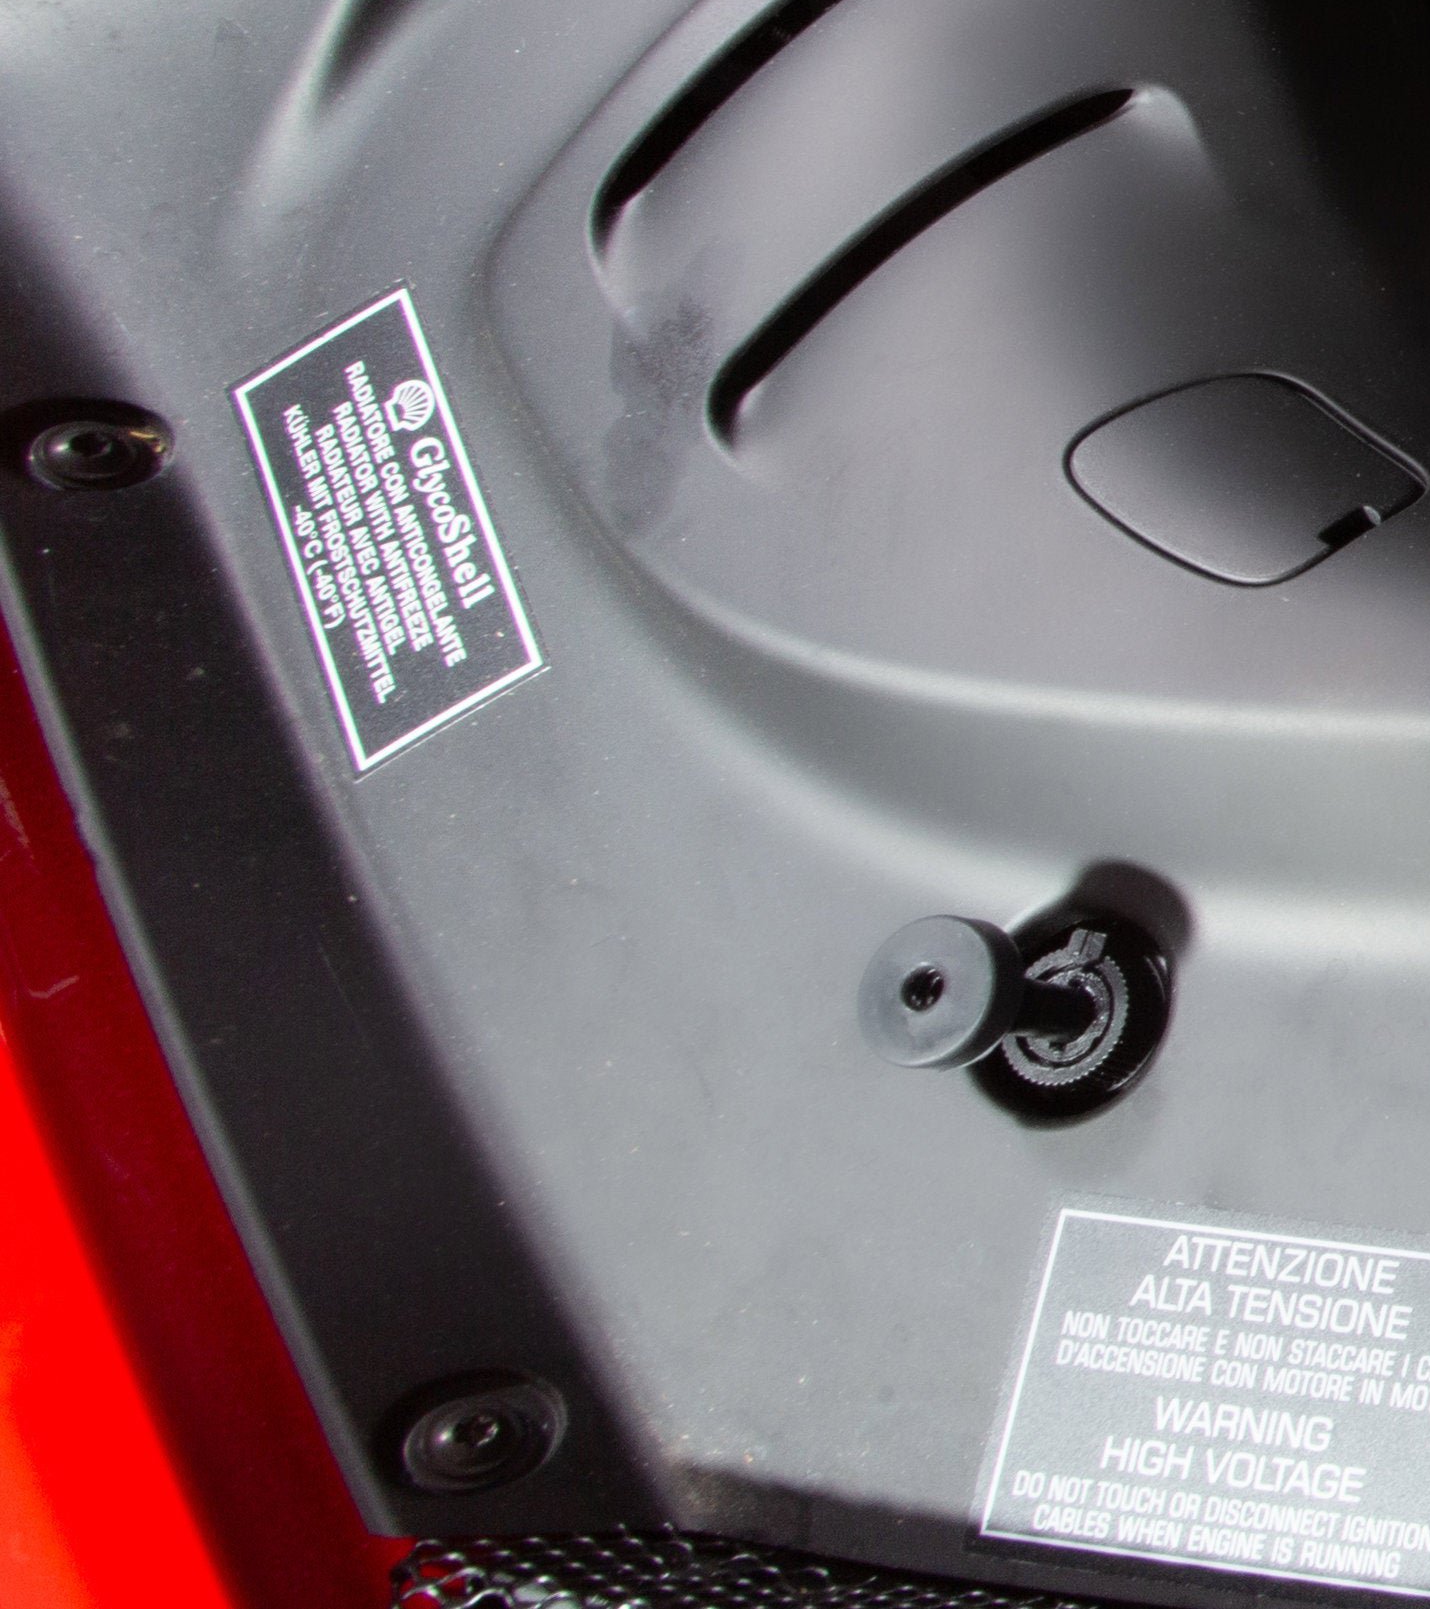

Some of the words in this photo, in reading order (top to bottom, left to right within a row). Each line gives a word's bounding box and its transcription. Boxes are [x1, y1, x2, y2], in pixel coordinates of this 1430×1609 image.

[284, 405, 321, 479] KÜHLER
[346, 361, 394, 463] RADIATORE
[308, 476, 332, 509] MIT
[381, 462, 409, 504] CON
[316, 424, 362, 526] RADIATEUR
[349, 527, 379, 574] AVEC
[366, 576, 405, 655] ANTIGEL
[334, 402, 378, 493] RADIATOR
[365, 491, 395, 540] WITH
[380, 541, 433, 651] ANTIFREEZE
[411, 437, 494, 609] GlycoShell
[319, 509, 395, 703] FROSTSCHUTZMITTEL
[394, 505, 466, 666] ANTICONGELANTE
[1163, 1235, 1400, 1294] ATTENZIONE
[1130, 1275, 1211, 1315] ALTA
[1228, 1285, 1412, 1340] TENSIONE
[1056, 1340, 1206, 1382] D'ACCENSIONE
[1211, 1360, 1257, 1388] CON
[1263, 1366, 1354, 1401] MOTORE
[1359, 1379, 1384, 1405] IN
[1062, 1311, 1110, 1339] NON
[1118, 1317, 1210, 1352] TOCCARE
[1215, 1330, 1229, 1354] E
[1234, 1332, 1283, 1361] NON
[1288, 1339, 1397, 1376] STACCARE
[1402, 1354, 1410, 1377] I
[1157, 1396, 1333, 1451] WARNING
[1100, 1436, 1194, 1479] HIGH
[1206, 1449, 1366, 1502] VOLTAGE
[1013, 1471, 1045, 1498] DO
[1048, 1475, 1093, 1504] NOT
[1096, 1481, 1165, 1514] TOUCH
[1169, 1492, 1201, 1519] OR
[1204, 1497, 1341, 1538] DISCONNECT
[1033, 1503, 1112, 1538] CABLES
[1118, 1515, 1183, 1548] WHEN
[1188, 1525, 1267, 1559] ENGINE
[1271, 1537, 1294, 1563] IS
[1300, 1540, 1401, 1578] RUNNING
